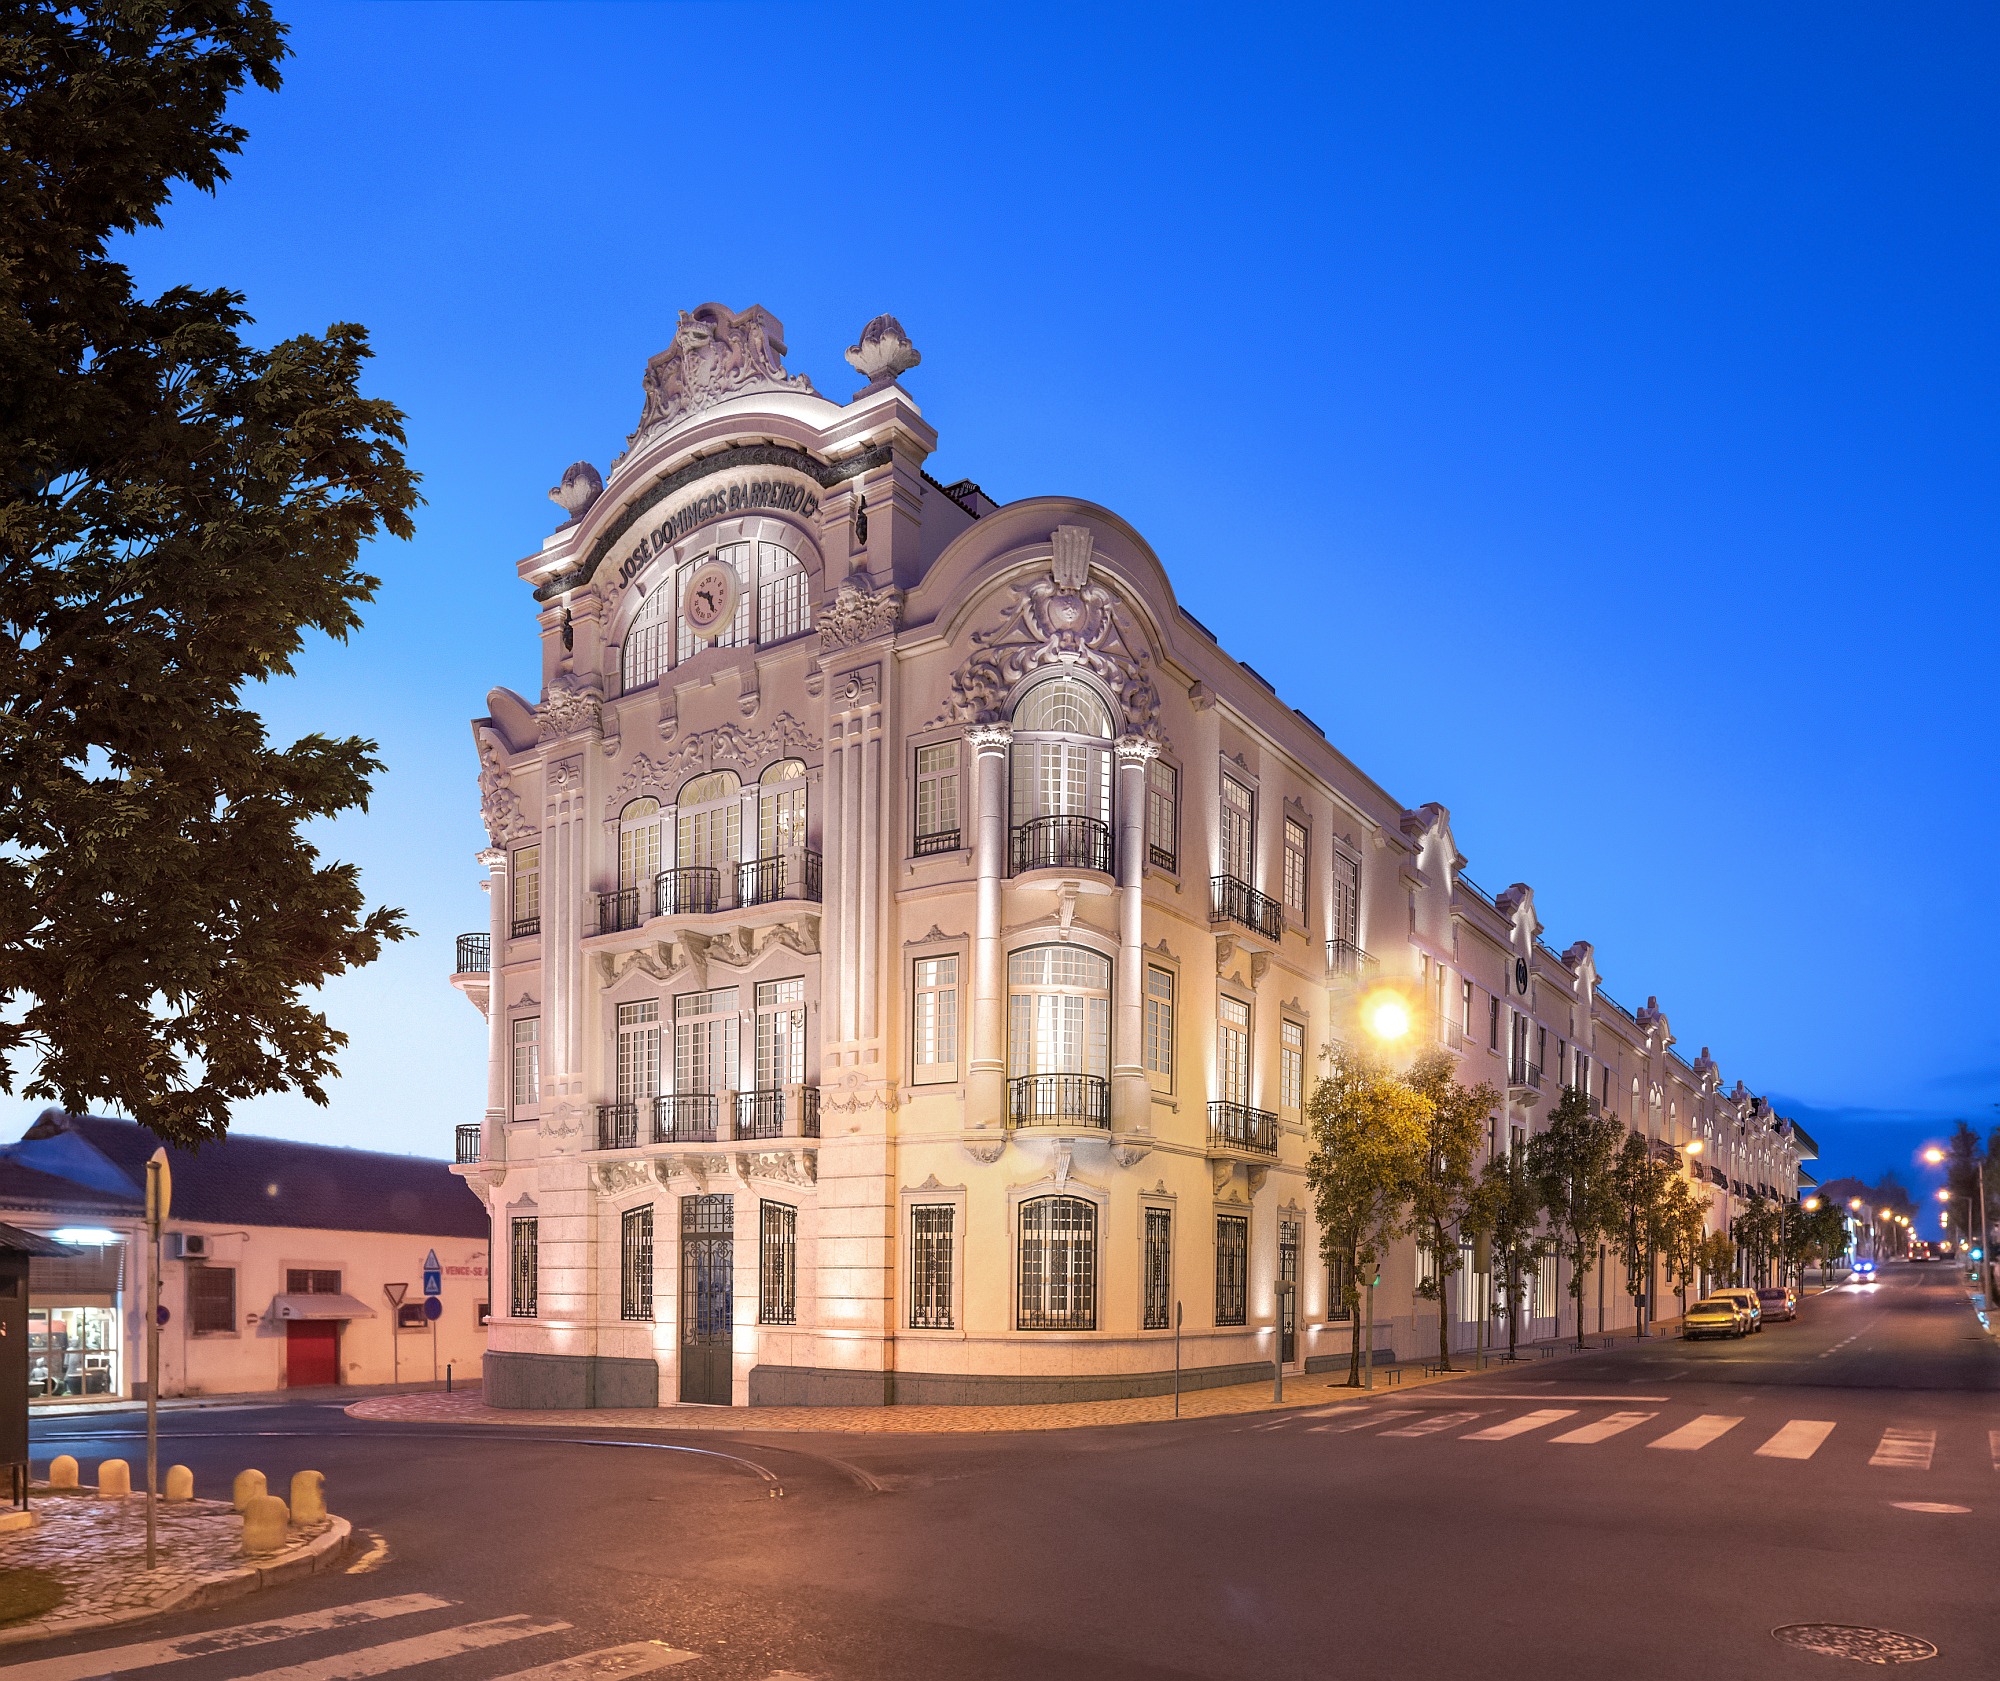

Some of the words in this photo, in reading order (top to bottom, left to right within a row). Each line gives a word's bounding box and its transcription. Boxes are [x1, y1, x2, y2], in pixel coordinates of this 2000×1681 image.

[619, 538, 653, 589] JOSÉ
[650, 490, 727, 553] DOMINGOS
[729, 481, 805, 513] BARREIRO
